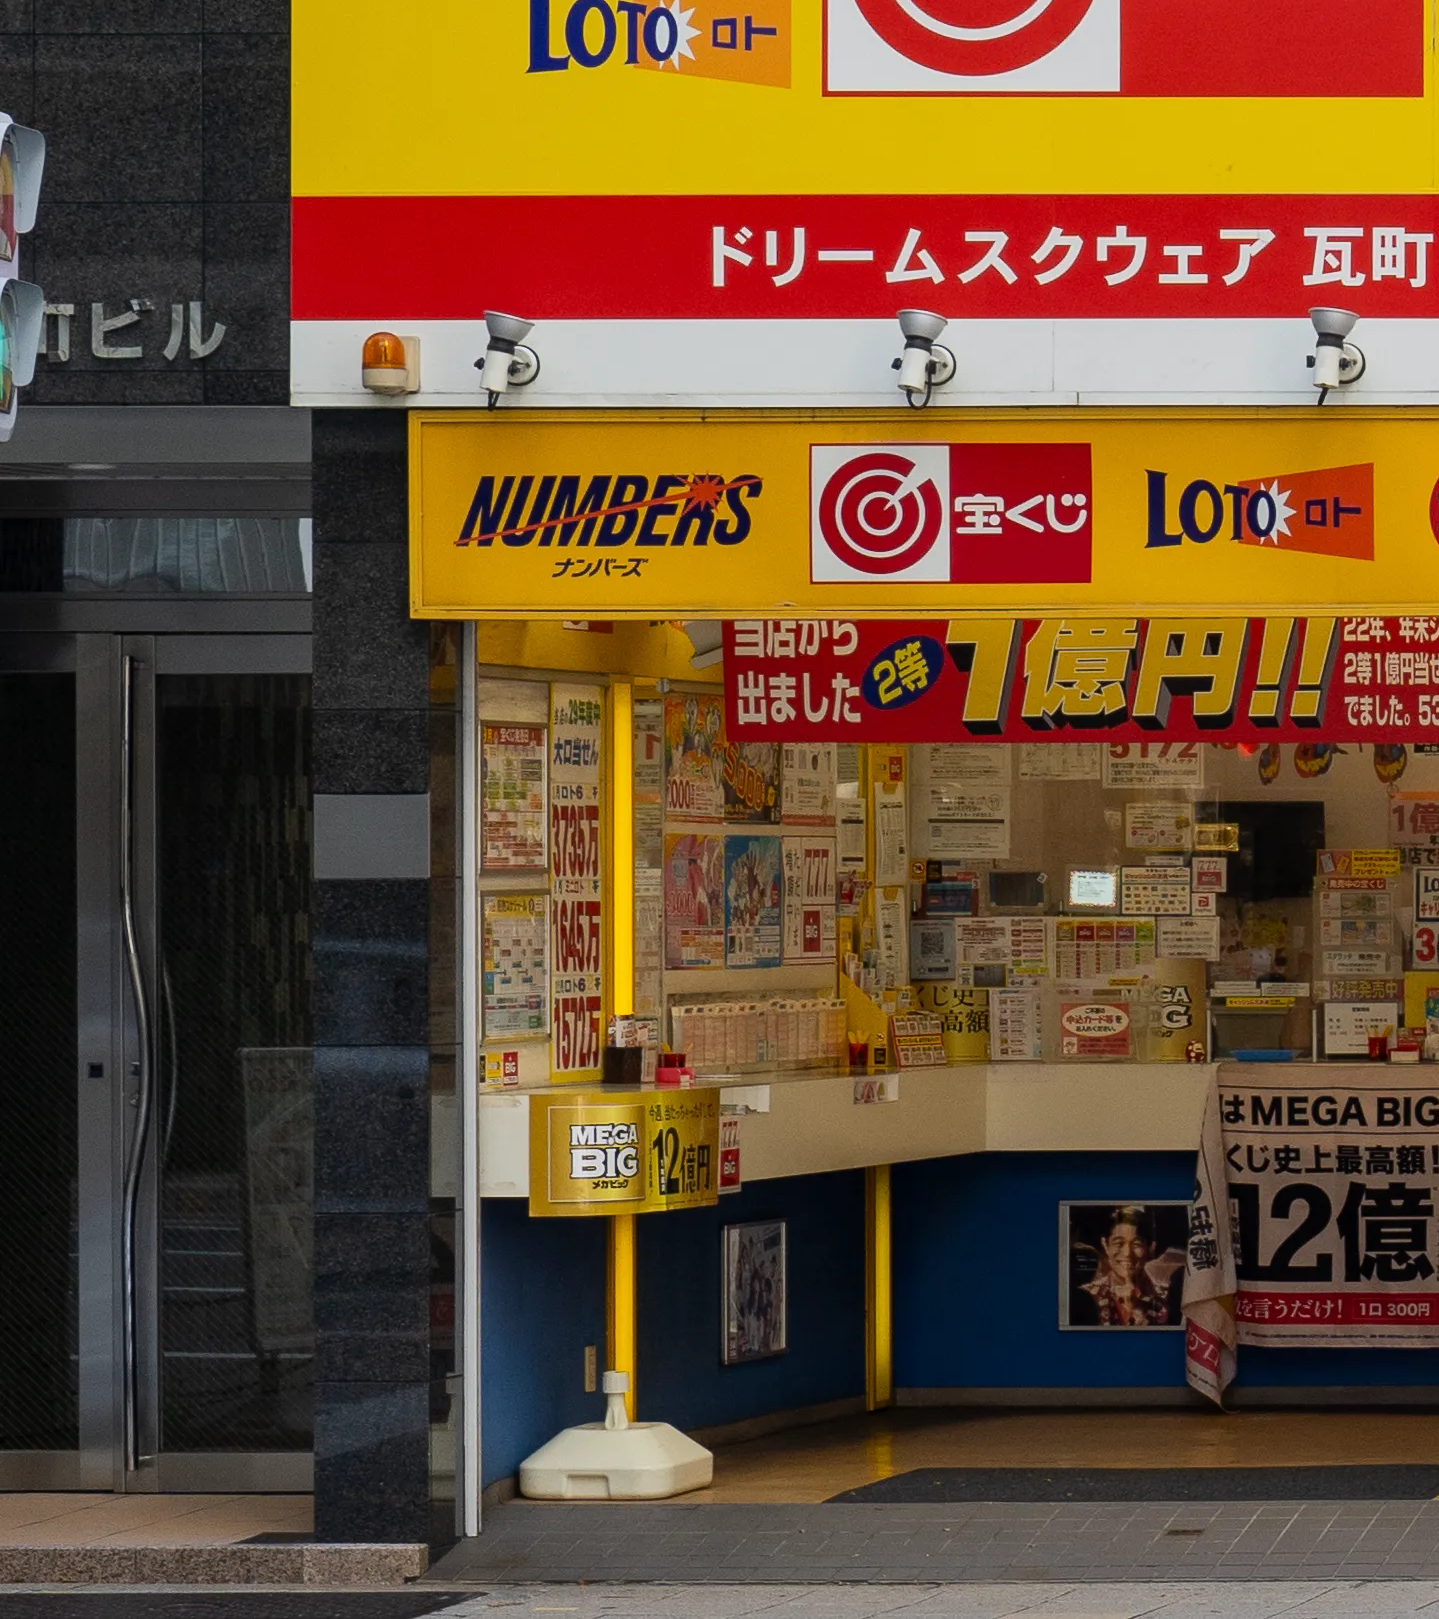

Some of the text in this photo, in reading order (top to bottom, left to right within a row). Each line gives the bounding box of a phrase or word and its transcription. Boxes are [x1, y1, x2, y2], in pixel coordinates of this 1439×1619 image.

[711, 15, 778, 51] ロト
[712, 225, 1434, 289] ドリームスクウェア 瓦町
[454, 473, 763, 548] NUMBERS
[953, 492, 1088, 536] 宝くじ
[1145, 469, 1278, 549] LOTO
[1304, 496, 1362, 528] ロト
[551, 557, 649, 579] ナンバーズ
[873, 639, 930, 705] 2等
[737, 670, 862, 725] 出ました
[569, 1123, 639, 1147] MEGA
[569, 1147, 639, 1179] BIG
[652, 1126, 711, 1195] 12億円
[1227, 1180, 1435, 1283] 12億
[1387, 1302, 1430, 1317] 300円
